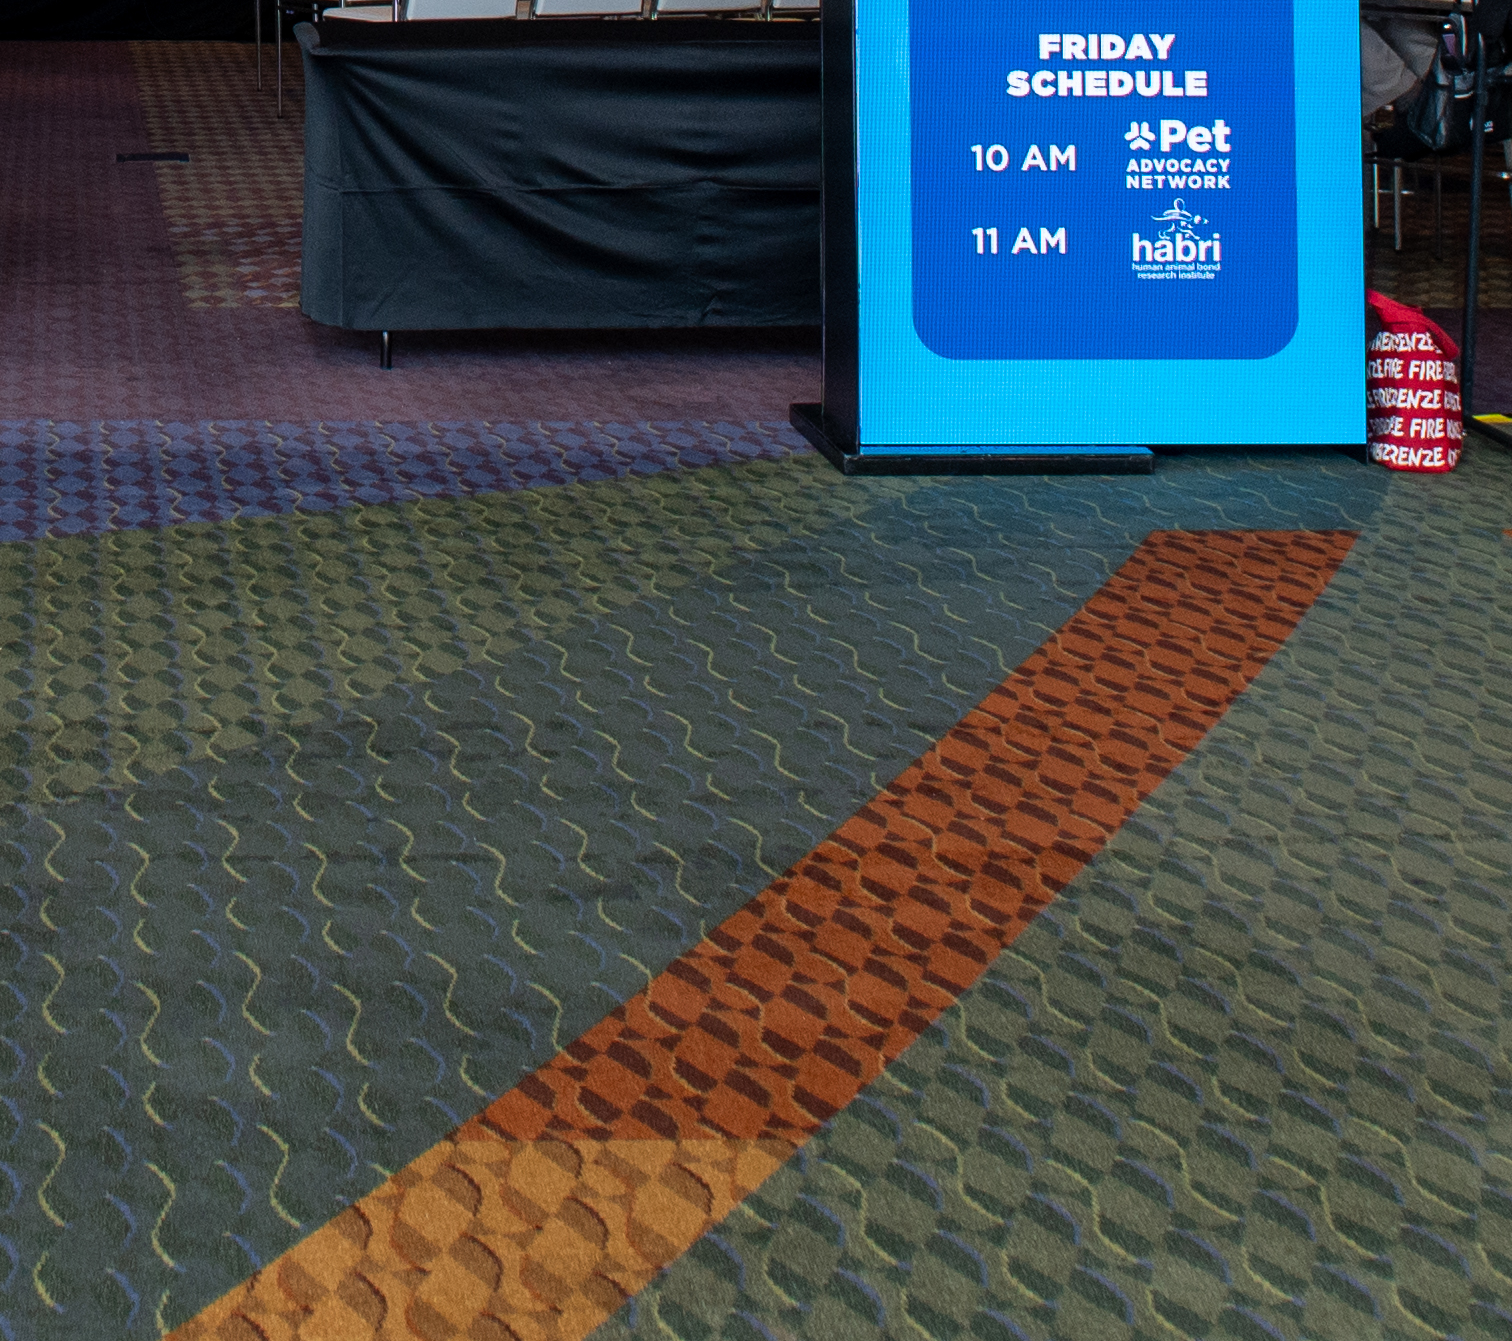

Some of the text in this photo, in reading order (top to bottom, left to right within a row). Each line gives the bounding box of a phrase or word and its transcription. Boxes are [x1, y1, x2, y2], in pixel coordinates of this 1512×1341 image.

[1039, 34, 1175, 59] FRIDAY
[1007, 71, 1207, 96] SCHEDULE
[1161, 120, 1231, 152] Pet
[972, 145, 1075, 171] 10 AM
[1127, 159, 1229, 172] ADVOCACY
[1127, 176, 1230, 188] NETWORK
[973, 228, 1065, 254] 11 AM
[1133, 231, 1220, 262] habri
[1408, 360, 1443, 381] FIRE
